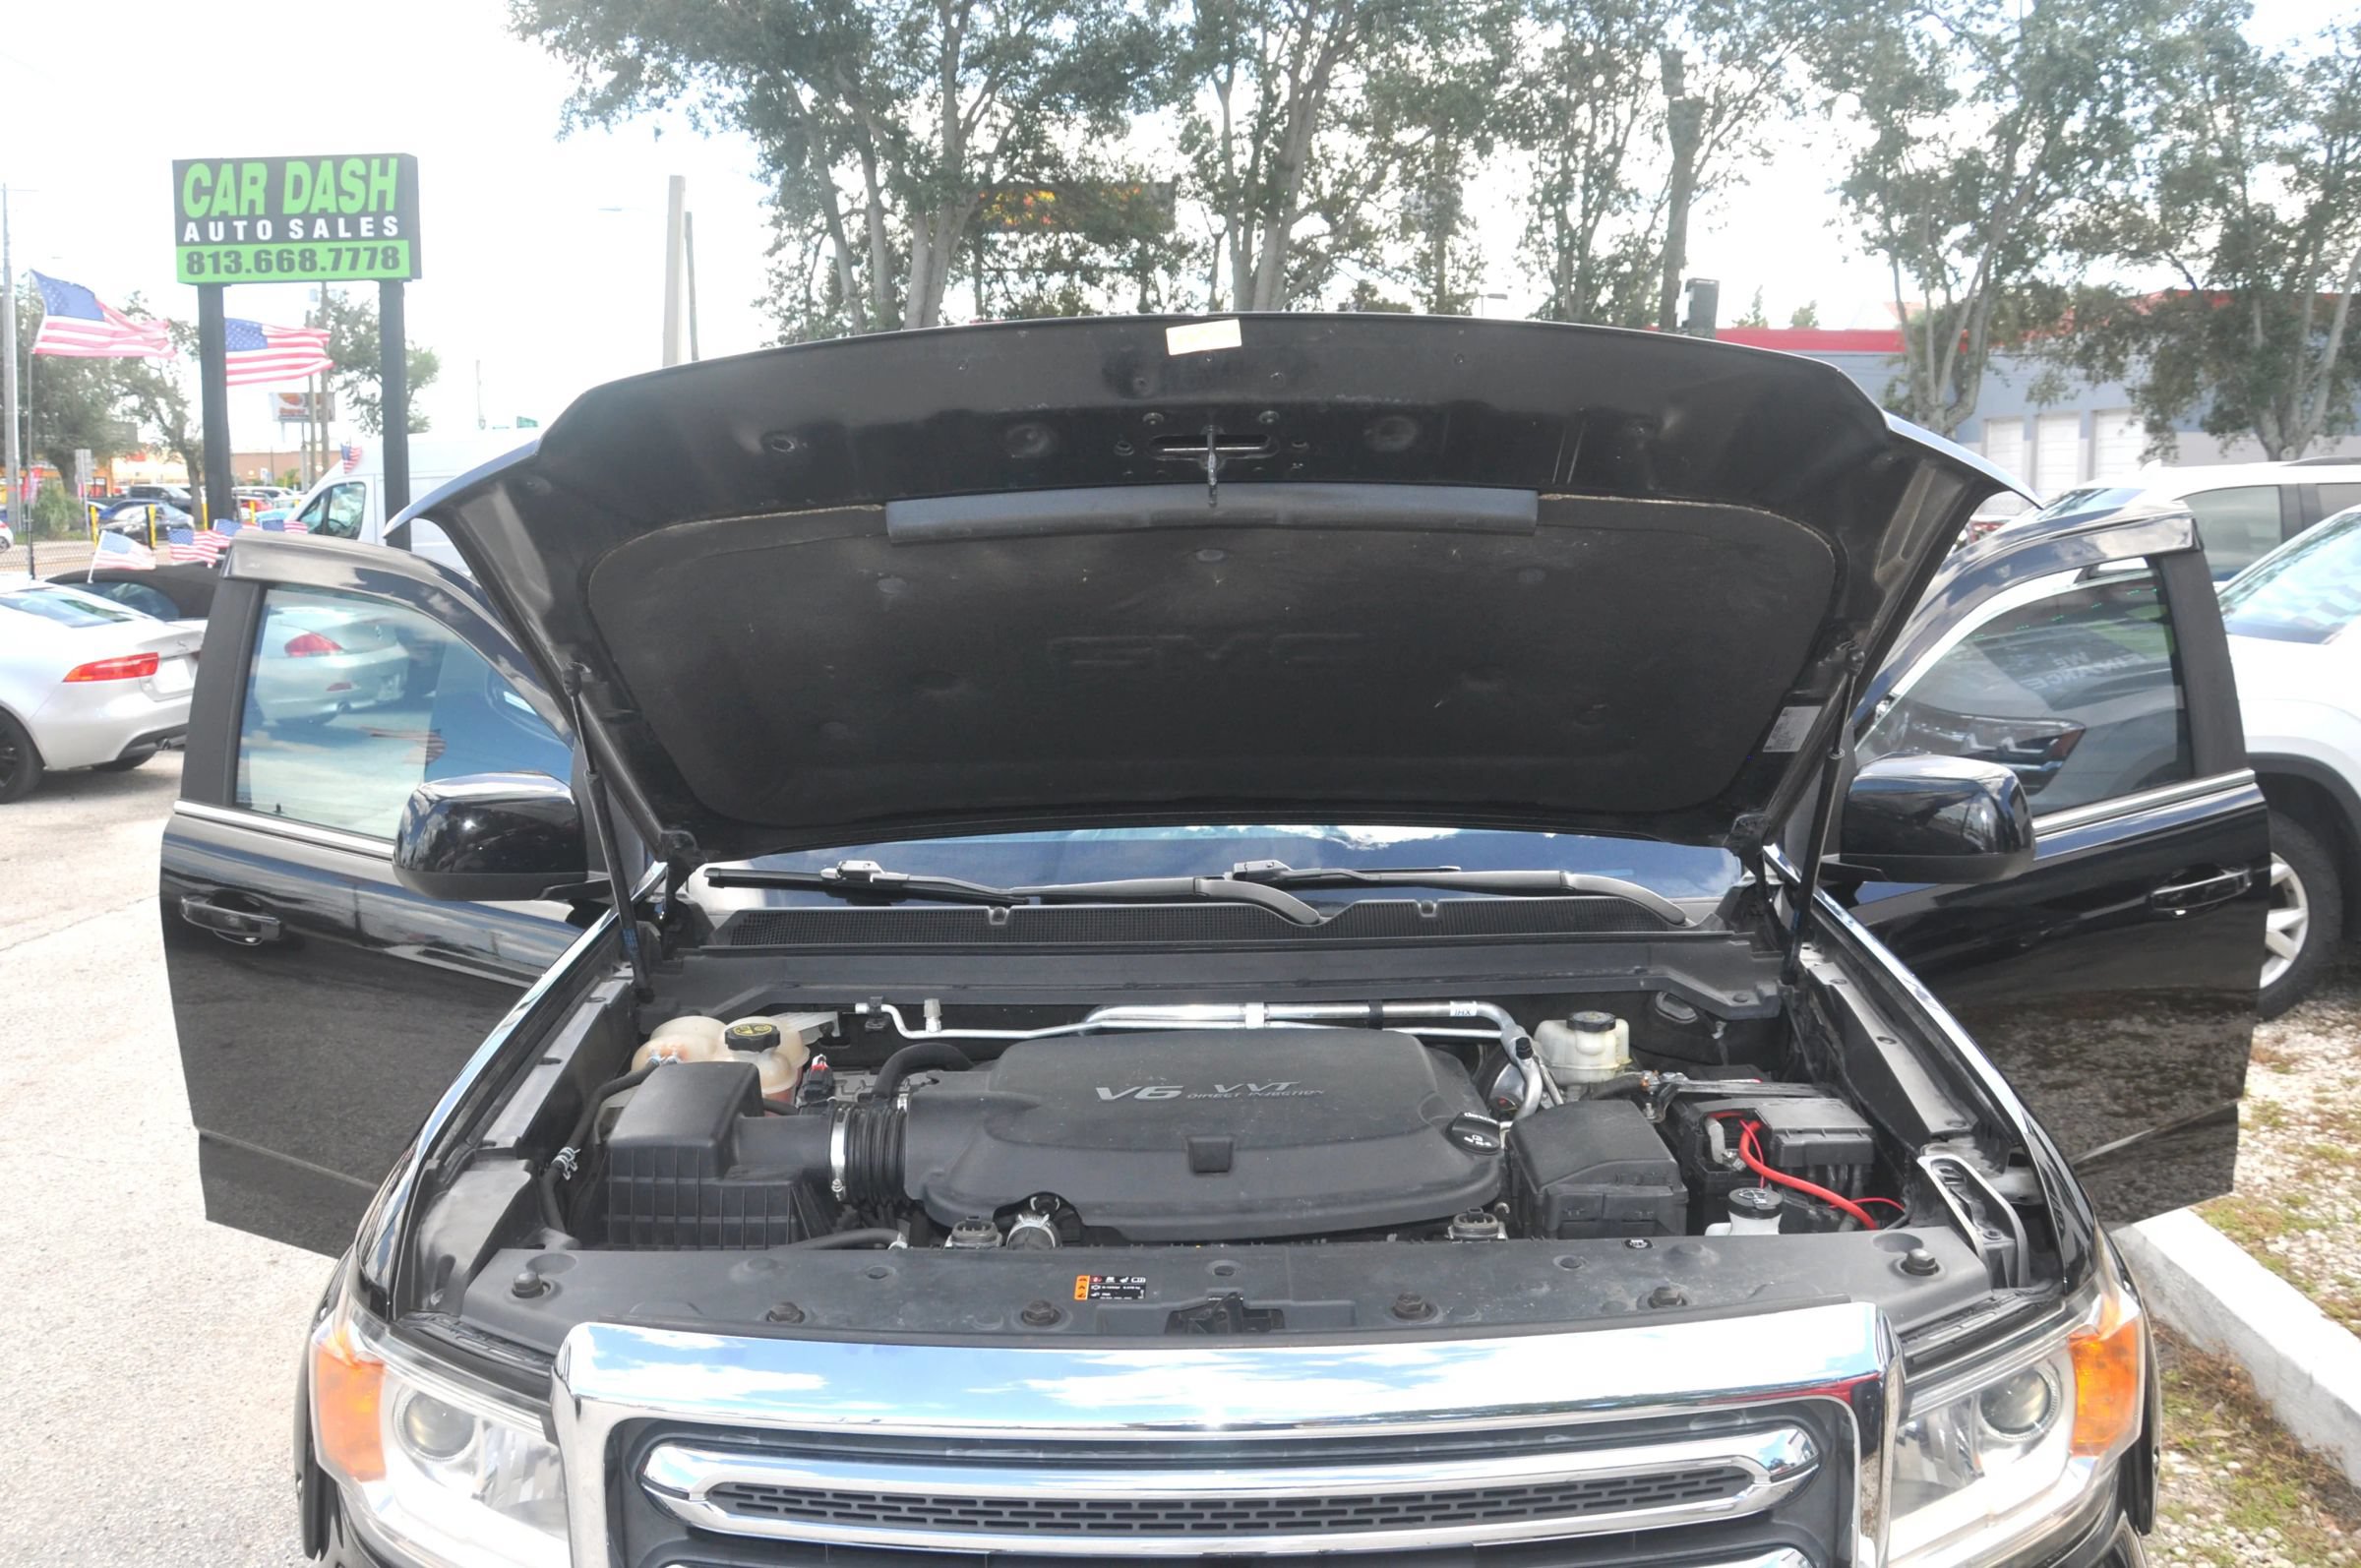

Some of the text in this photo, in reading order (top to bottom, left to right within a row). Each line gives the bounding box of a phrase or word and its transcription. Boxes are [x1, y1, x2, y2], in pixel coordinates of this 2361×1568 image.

[182, 157, 397, 218] CAR DASH
[184, 215, 398, 242] AUTO SALES
[186, 246, 400, 275] 813.668.7778
[1095, 1085, 1184, 1101] V6
[1186, 1089, 1325, 1100] DIRECT INJECTION
[1214, 1080, 1302, 1093] VVT
